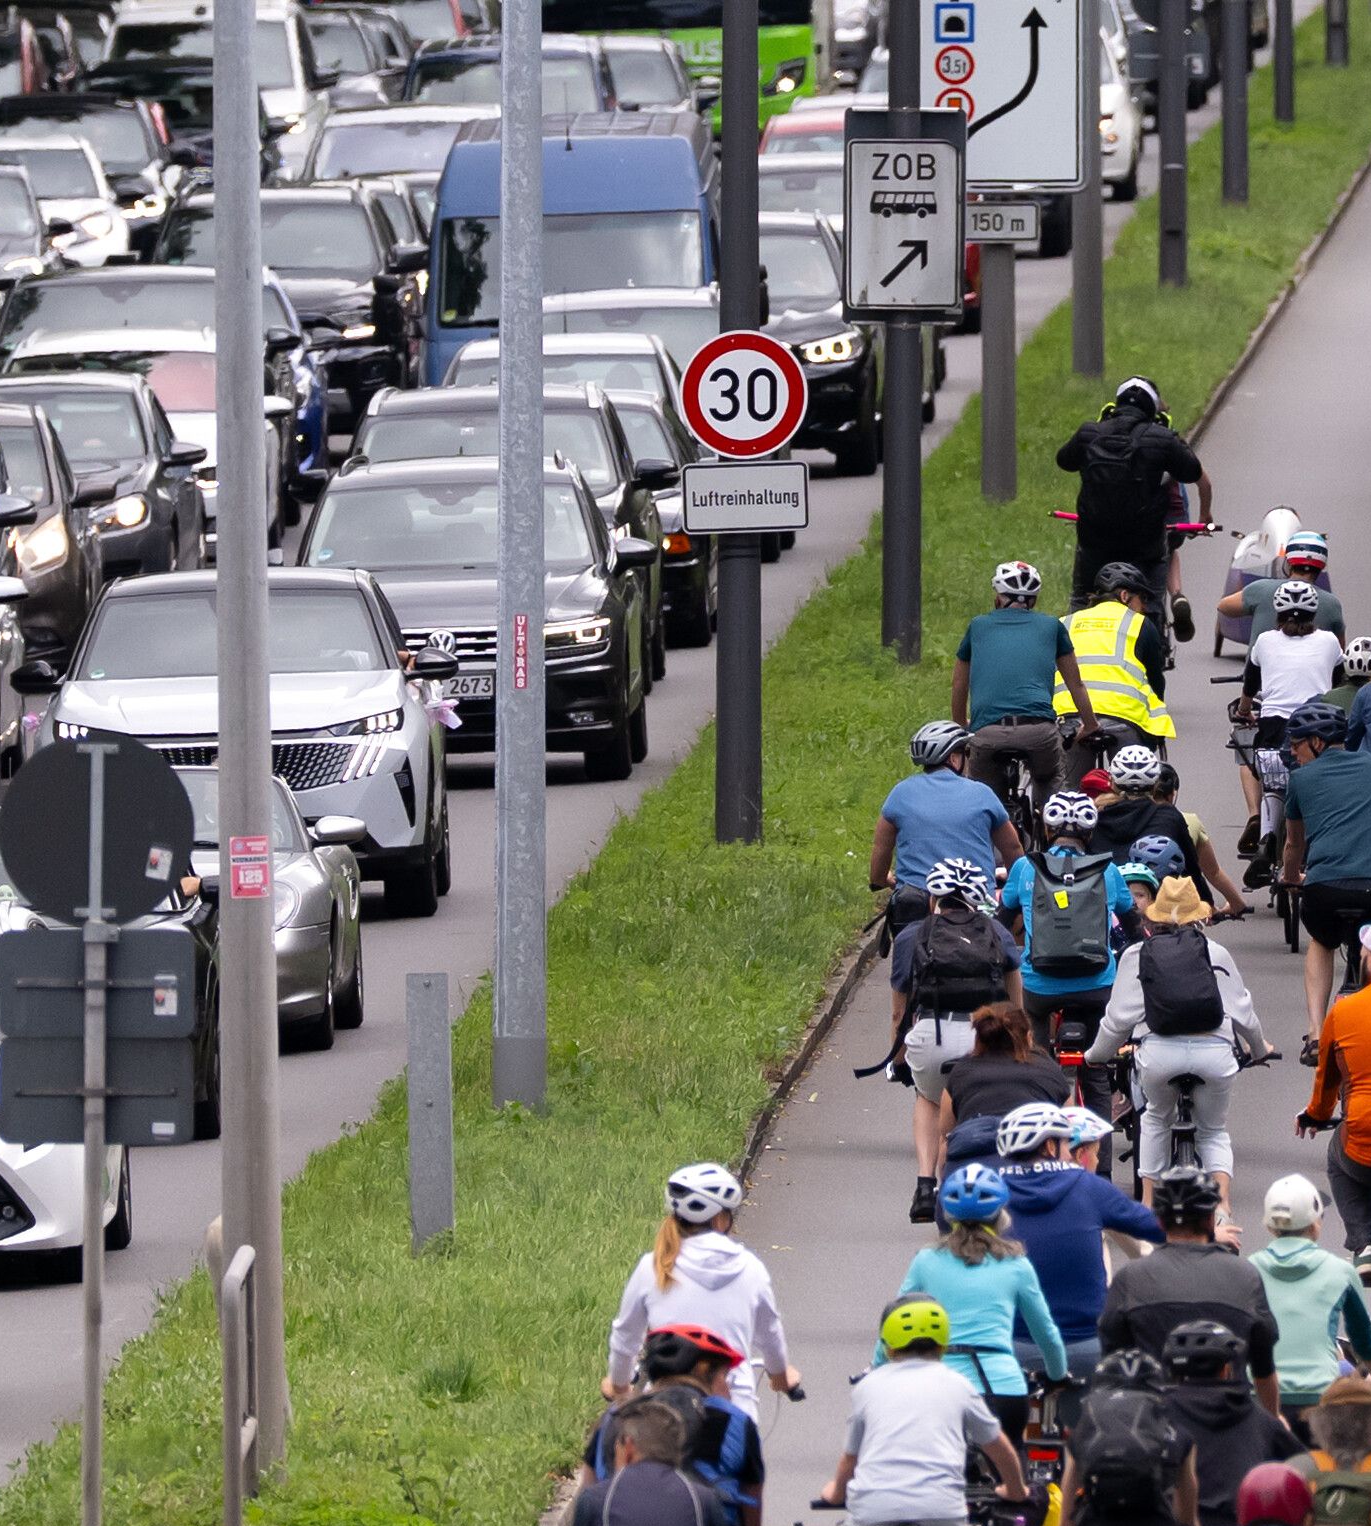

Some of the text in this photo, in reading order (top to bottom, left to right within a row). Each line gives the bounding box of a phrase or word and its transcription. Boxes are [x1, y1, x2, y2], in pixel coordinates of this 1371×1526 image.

[872, 153, 936, 180] ZOB
[972, 213, 1025, 231] 150 m
[709, 368, 777, 421] 30
[692, 490, 799, 507] Luftreinhaltung
[450, 677, 491, 694] 2673
